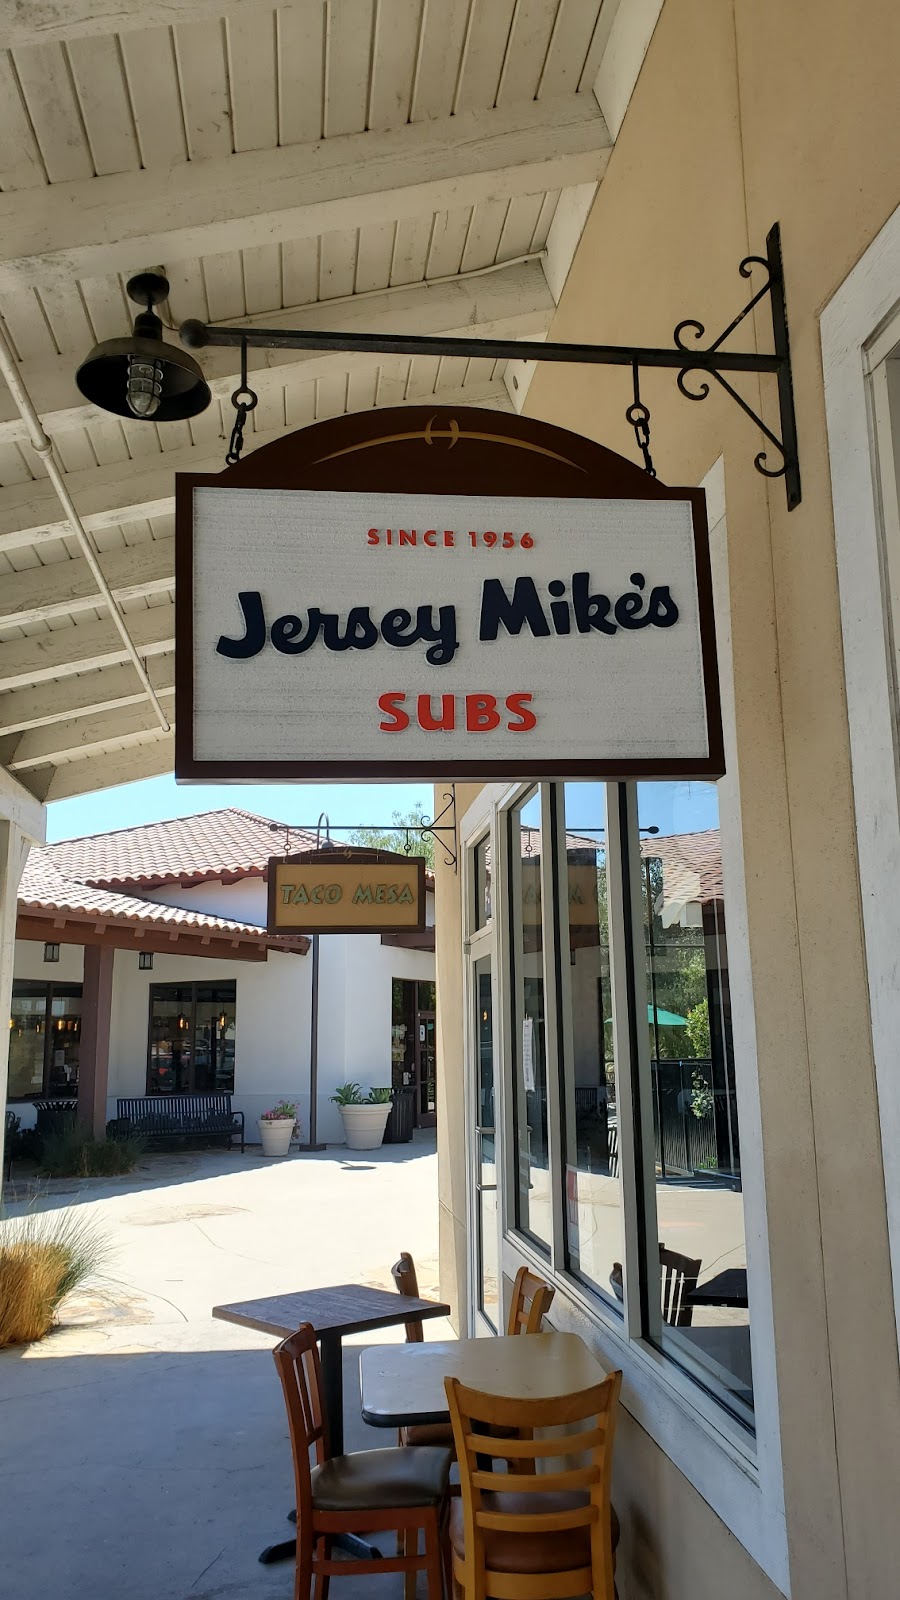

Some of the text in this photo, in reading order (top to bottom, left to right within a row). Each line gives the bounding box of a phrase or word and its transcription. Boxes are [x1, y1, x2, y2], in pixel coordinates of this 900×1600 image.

[367, 528, 535, 549] SINCE 1956
[215, 571, 680, 666] Jersey Mike's
[377, 691, 538, 733] SUBS
[280, 883, 415, 905] TACO MESA
